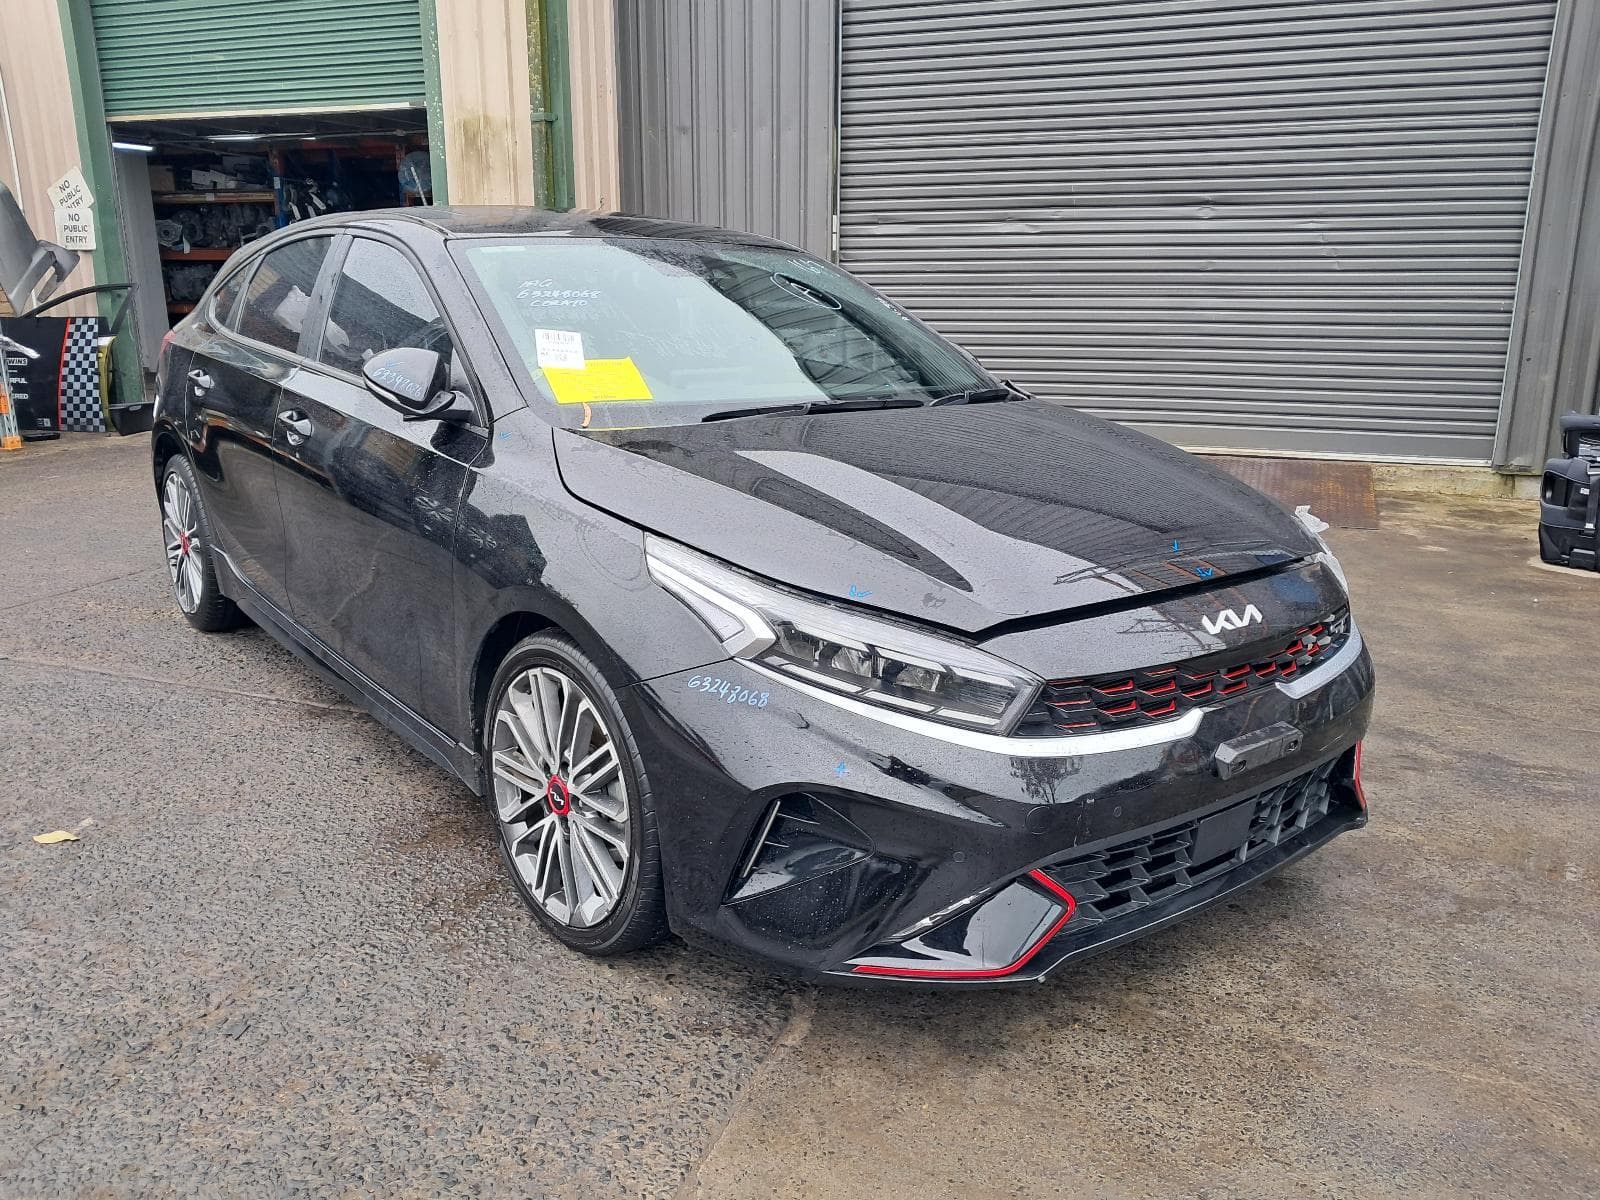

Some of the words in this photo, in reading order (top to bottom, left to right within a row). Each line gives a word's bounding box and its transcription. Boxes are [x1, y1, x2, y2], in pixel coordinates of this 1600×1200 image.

[59, 180, 71, 193] NO
[60, 185, 81, 206] PUBLIC
[68, 213, 80, 222] NO
[63, 224, 88, 233] PUBLIC
[65, 235, 88, 244] ENTRY
[1202, 604, 1263, 635] KIA
[687, 675, 770, 708] 63248068
